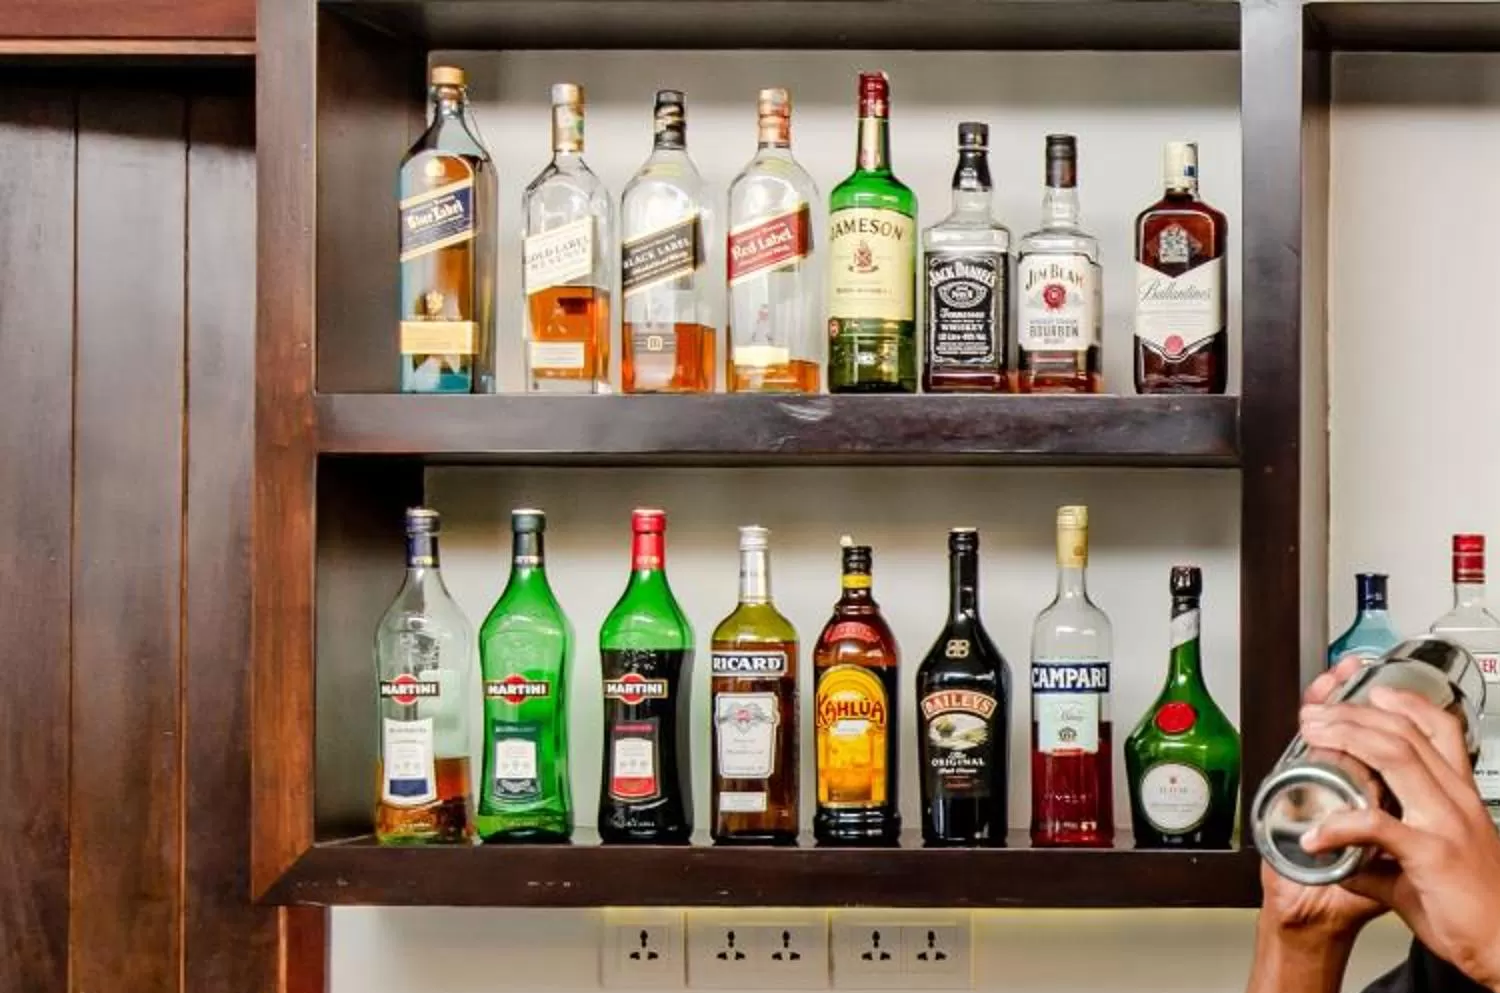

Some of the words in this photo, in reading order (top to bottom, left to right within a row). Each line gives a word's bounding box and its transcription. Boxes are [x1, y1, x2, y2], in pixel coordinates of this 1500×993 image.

[830, 217, 904, 241] JAMESON
[713, 656, 782, 671] RICARD
[1032, 667, 1107, 689] CAMPARI
[381, 683, 437, 695] MARTINI
[488, 683, 547, 695] MARTINI
[607, 683, 662, 695] MARTINI
[925, 693, 992, 714] BAILEYS
[931, 758, 985, 767] ORIGINAL
